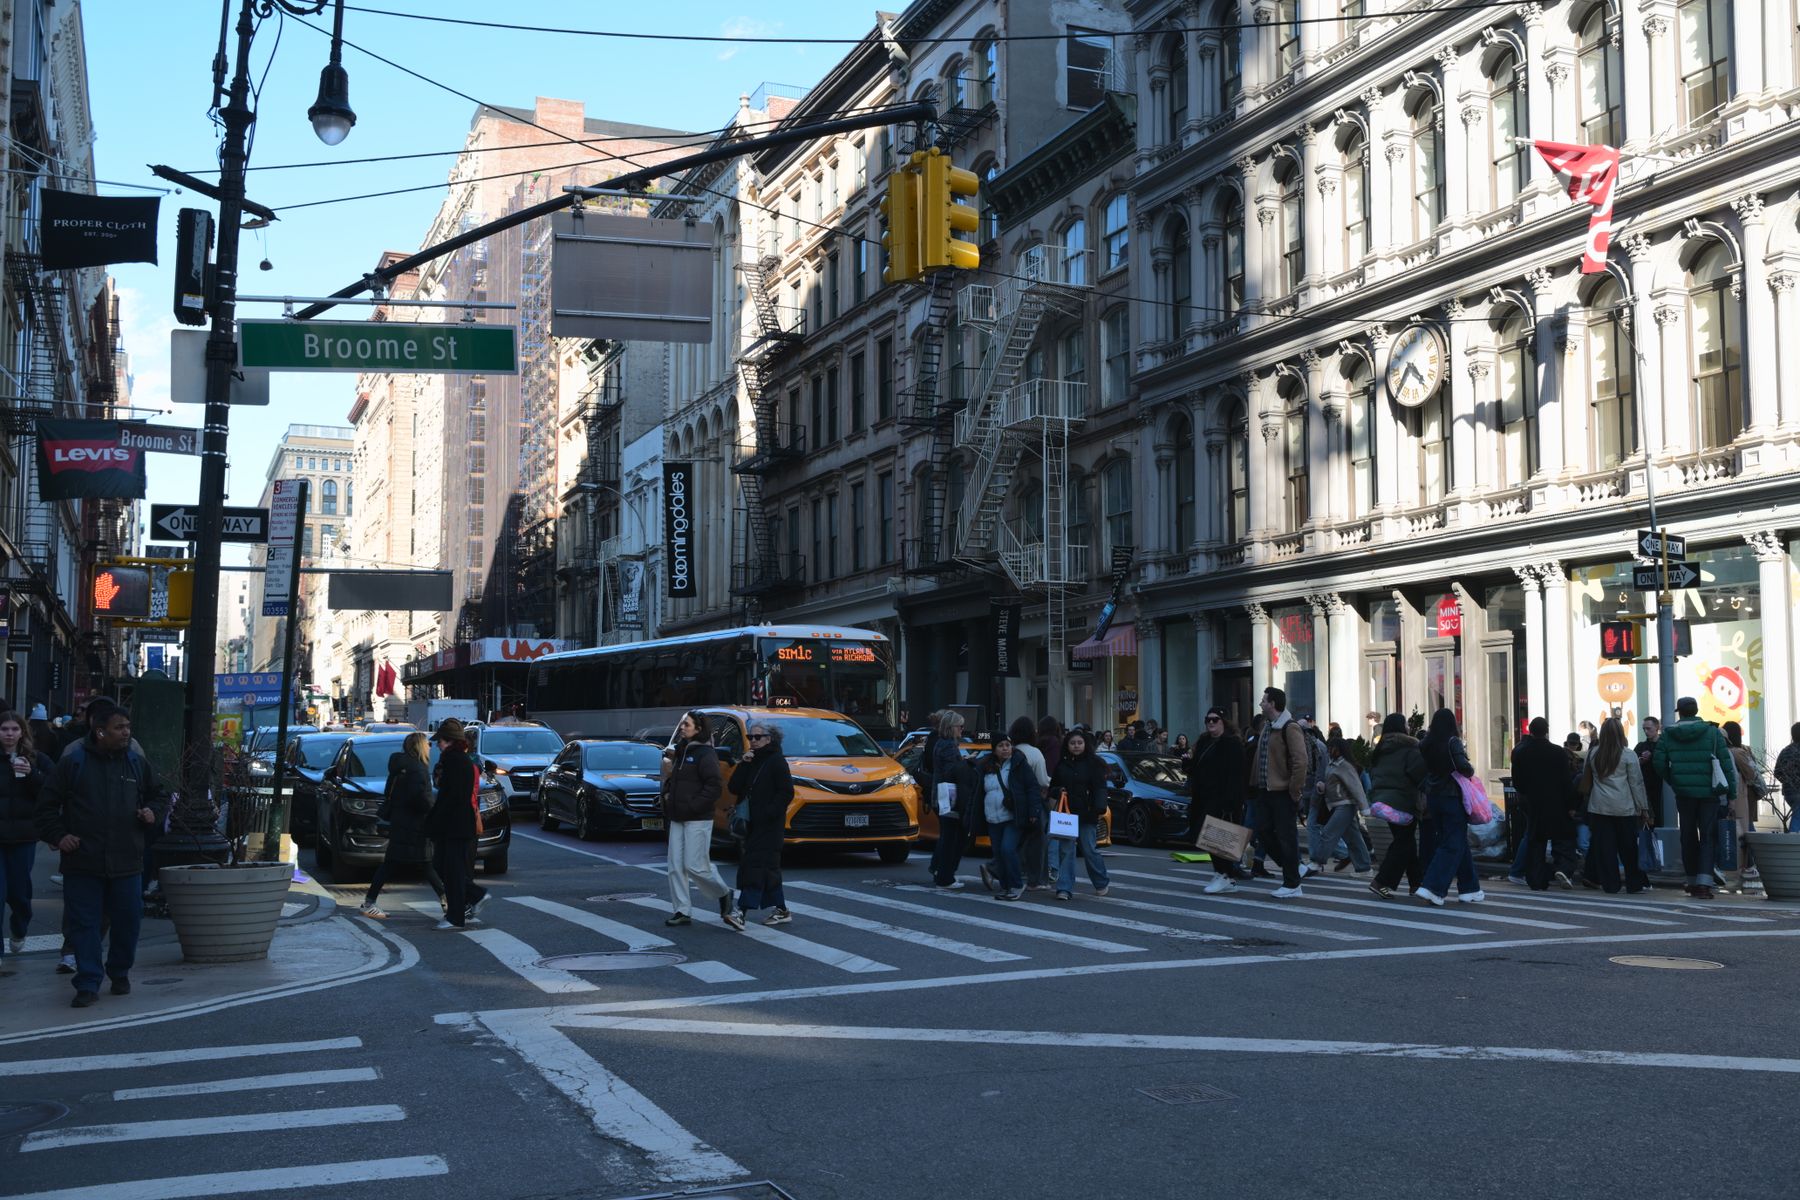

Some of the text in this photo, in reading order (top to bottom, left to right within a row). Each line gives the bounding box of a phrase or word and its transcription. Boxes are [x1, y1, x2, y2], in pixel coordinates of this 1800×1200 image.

[53, 219, 147, 230] PROPER CLOTH
[303, 333, 458, 361] Broome St
[121, 429, 193, 453] Broome St
[274, 481, 282, 494] 3
[1645, 538, 1660, 551] ONE
[268, 548, 275, 560] 2
[1640, 570, 1687, 584] ON WAY
[1440, 606, 1459, 617] MINI
[1279, 613, 1301, 631] LIFE
[997, 609, 1009, 672] STEVE MADDEN
[844, 654, 875, 662] RICHMOND
